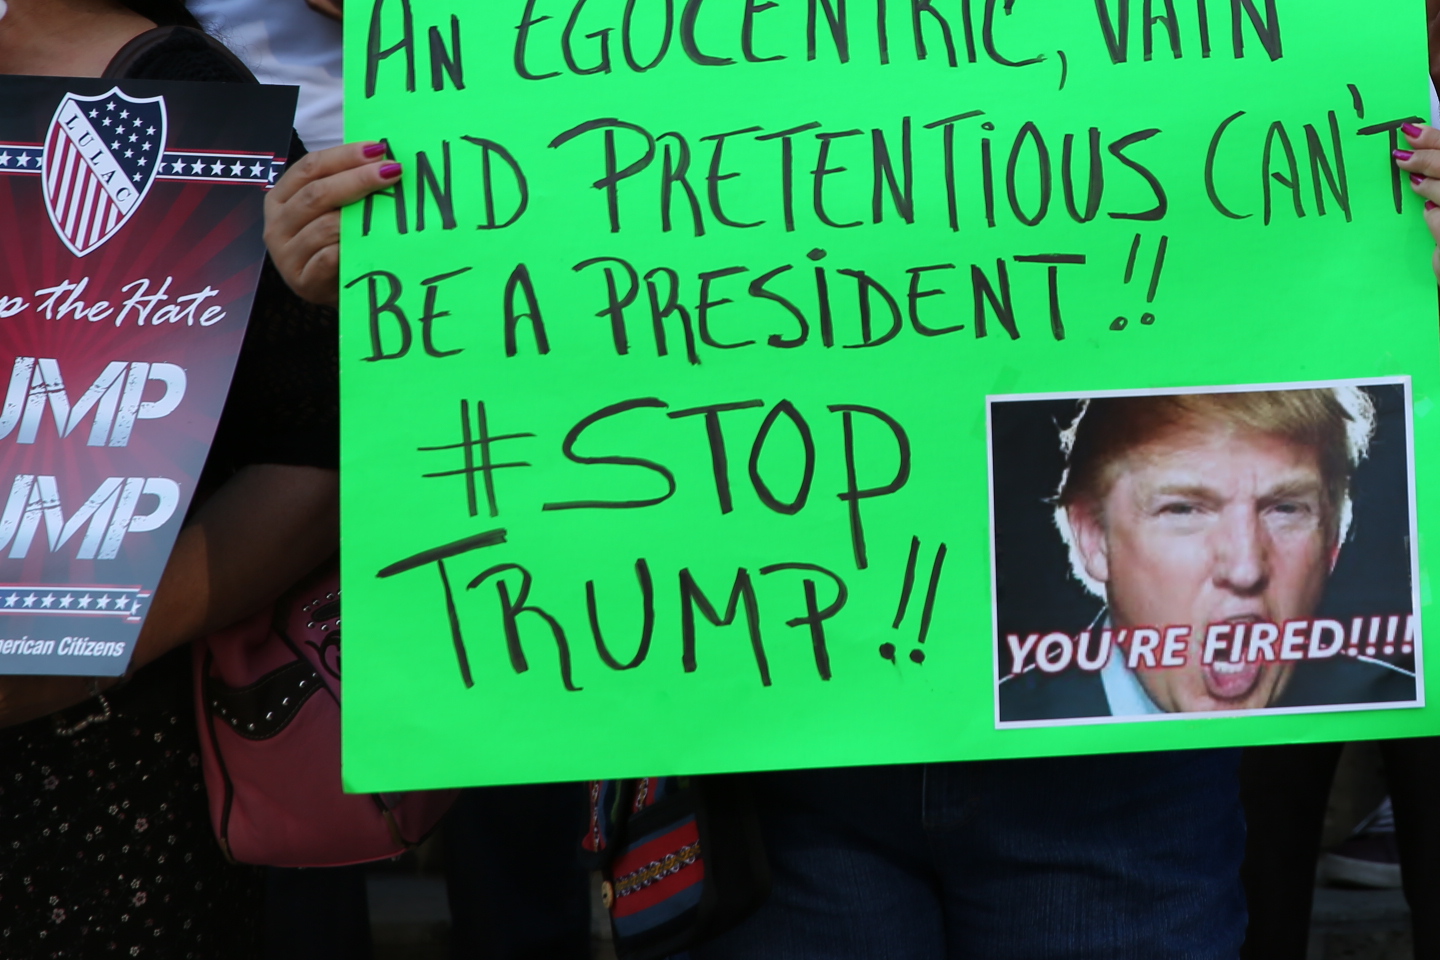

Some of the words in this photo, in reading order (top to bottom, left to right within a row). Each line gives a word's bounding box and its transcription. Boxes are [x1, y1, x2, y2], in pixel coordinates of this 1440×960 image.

[63, 112, 132, 205] LULAC
[362, 133, 529, 238] AND
[1204, 83, 1425, 227] CAN'T
[34, 275, 115, 321] the
[113, 274, 227, 328] Hate
[344, 266, 473, 363] BE
[503, 262, 551, 359] A
[416, 396, 912, 571] #STOP
[0, 635, 56, 656] erican
[57, 635, 127, 658] Citizens
[376, 527, 948, 693] TRUMP!!
[1006, 624, 1191, 677] YOU'RE
